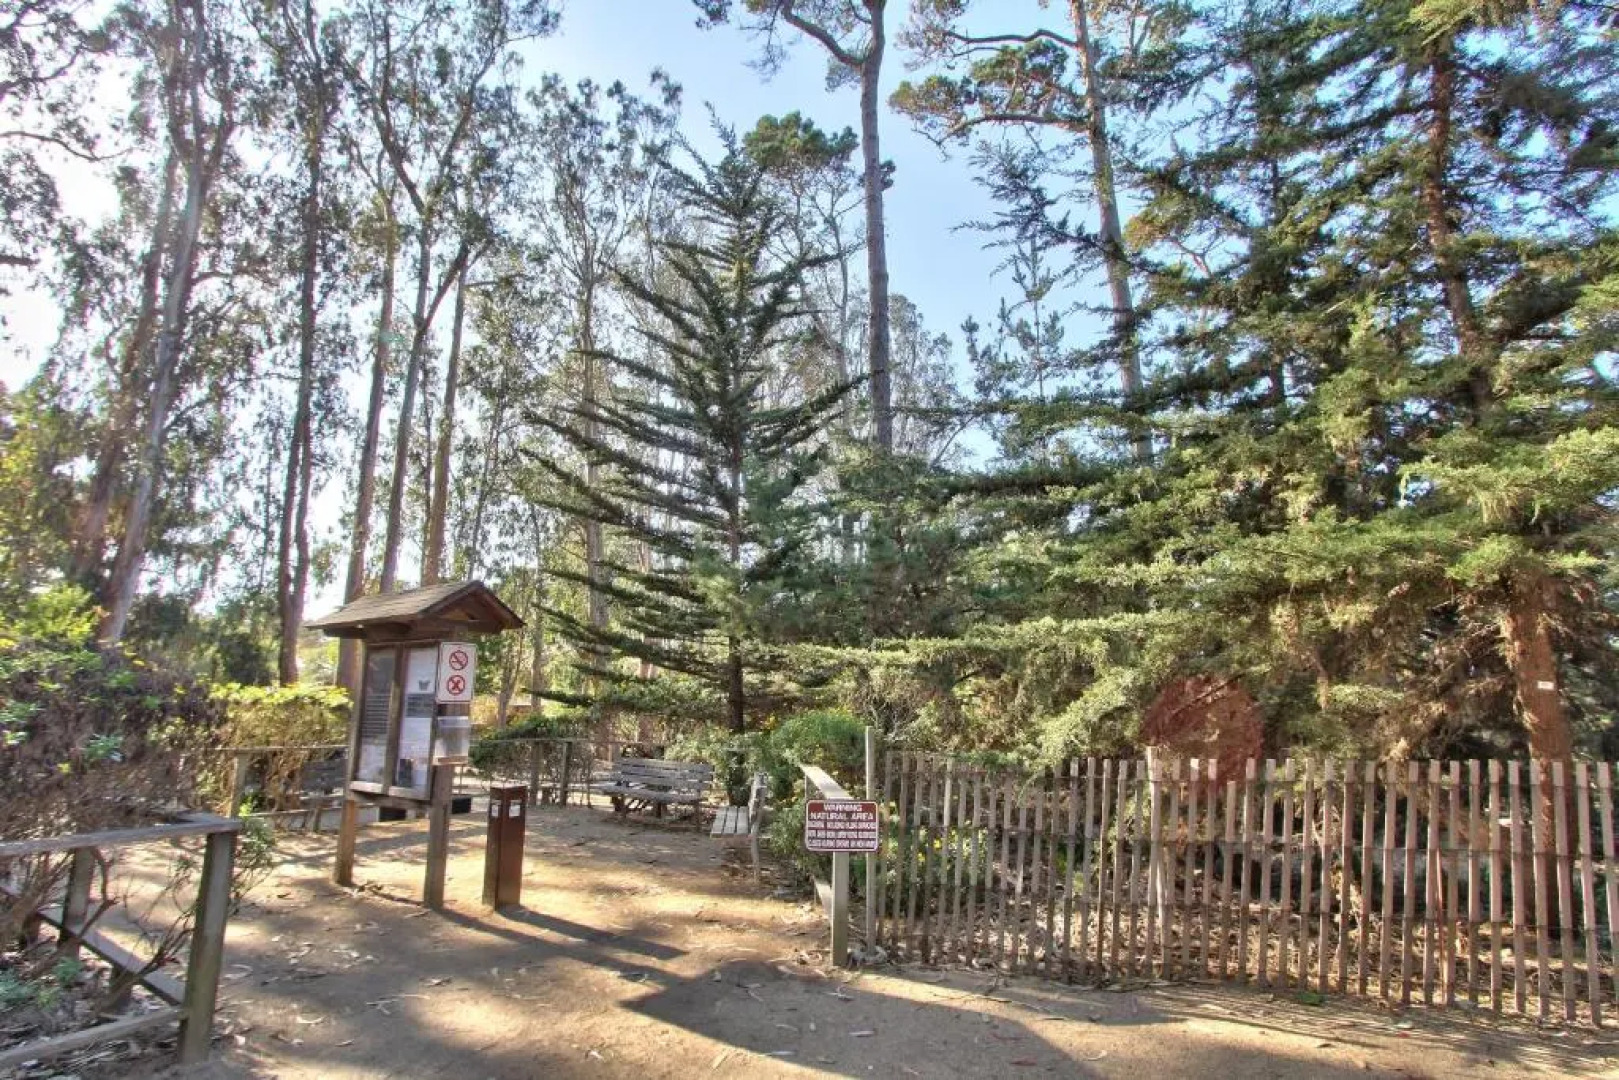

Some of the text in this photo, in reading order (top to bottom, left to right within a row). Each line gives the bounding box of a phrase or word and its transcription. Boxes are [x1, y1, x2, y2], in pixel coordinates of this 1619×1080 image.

[823, 803, 863, 811] WARNING
[810, 812, 874, 820] NATURAL AREA
